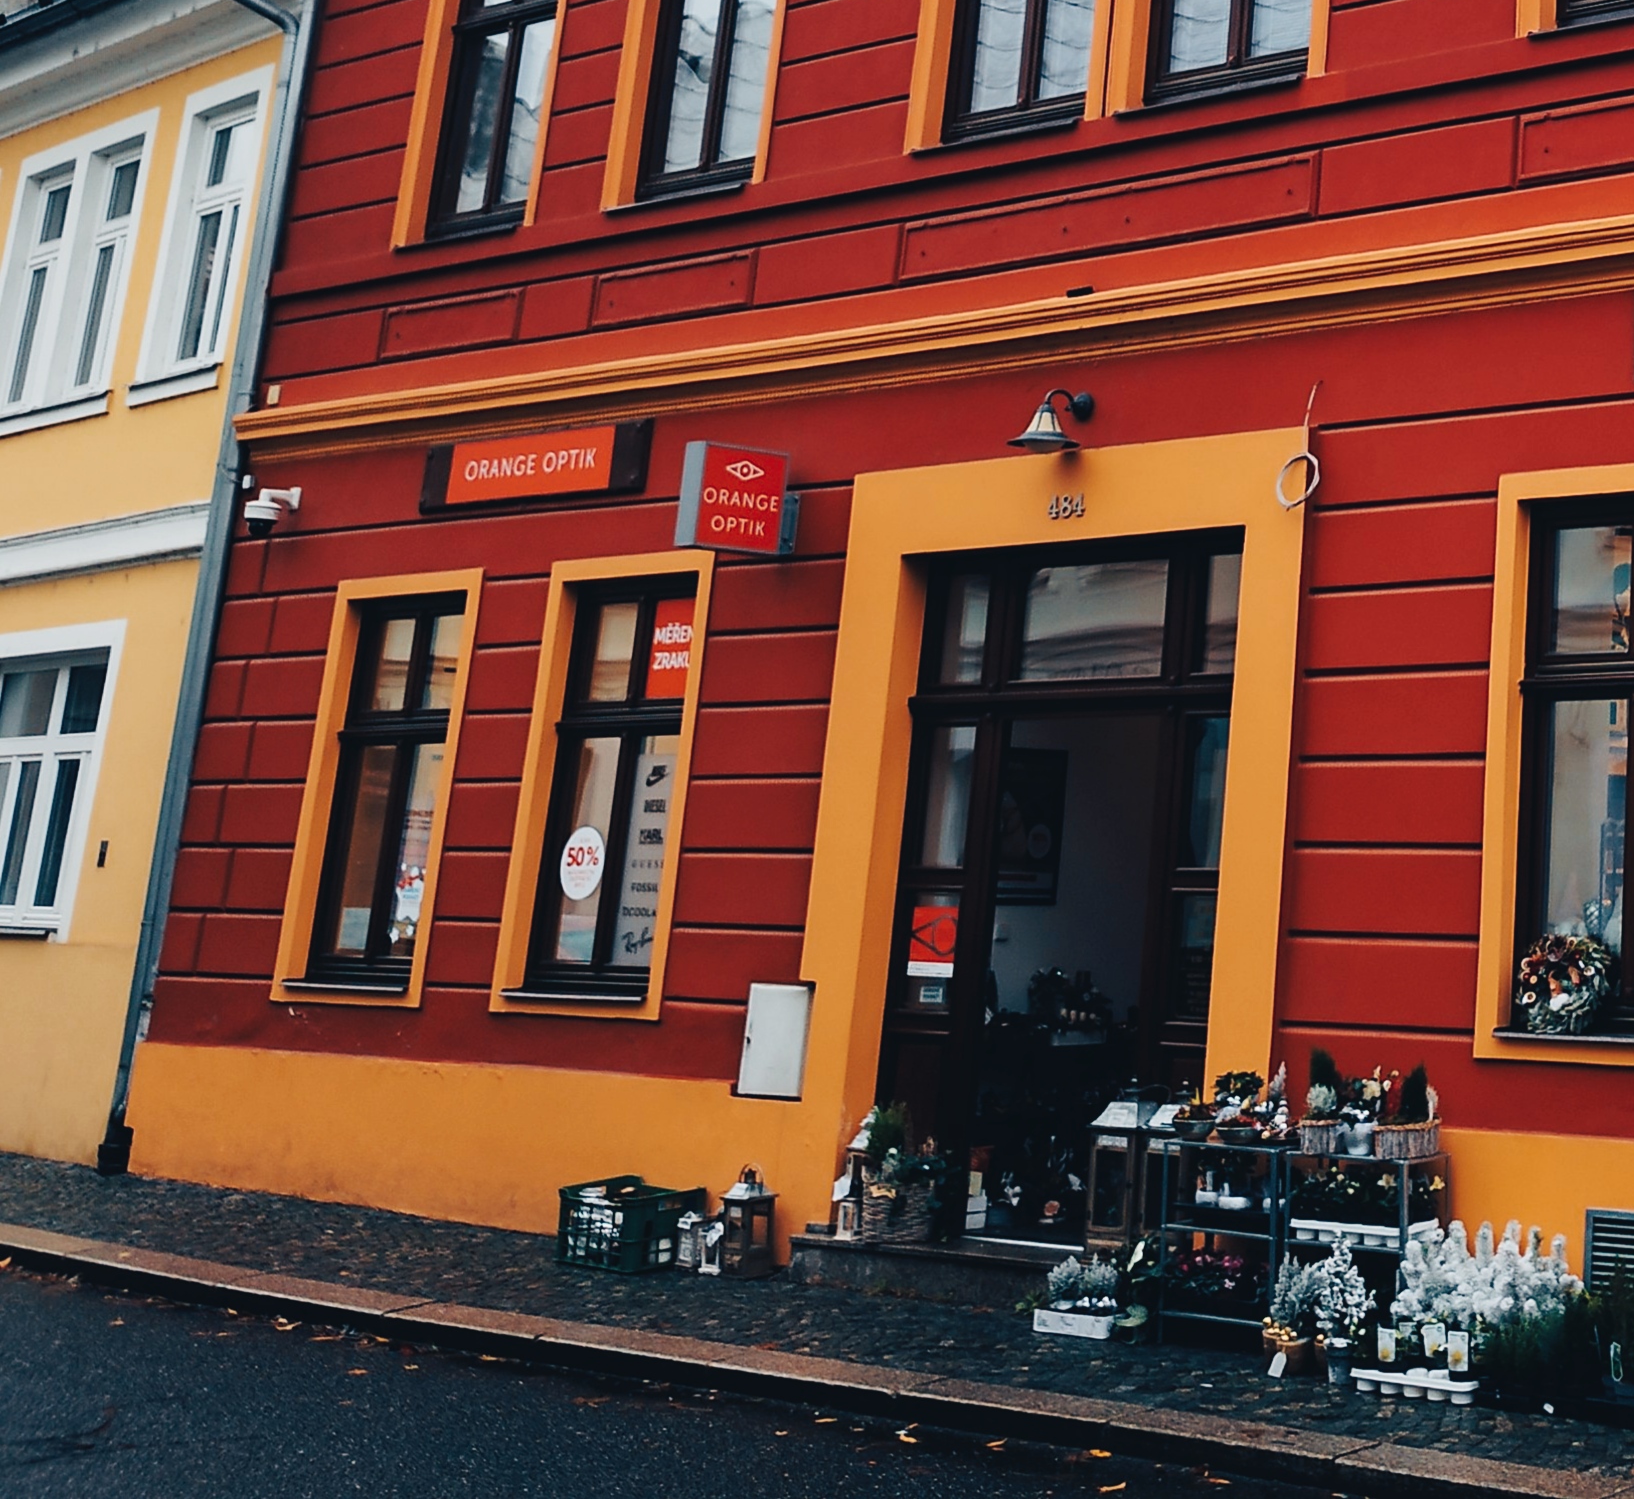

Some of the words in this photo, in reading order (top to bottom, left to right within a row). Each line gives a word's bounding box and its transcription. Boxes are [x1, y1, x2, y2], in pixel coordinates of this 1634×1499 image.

[464, 454, 537, 481] ORANGE
[542, 447, 597, 473] OPTIK
[703, 486, 779, 512] ORANGE
[1048, 493, 1086, 520] 484
[711, 514, 766, 537] OPTIK
[566, 845, 600, 867] 50%
